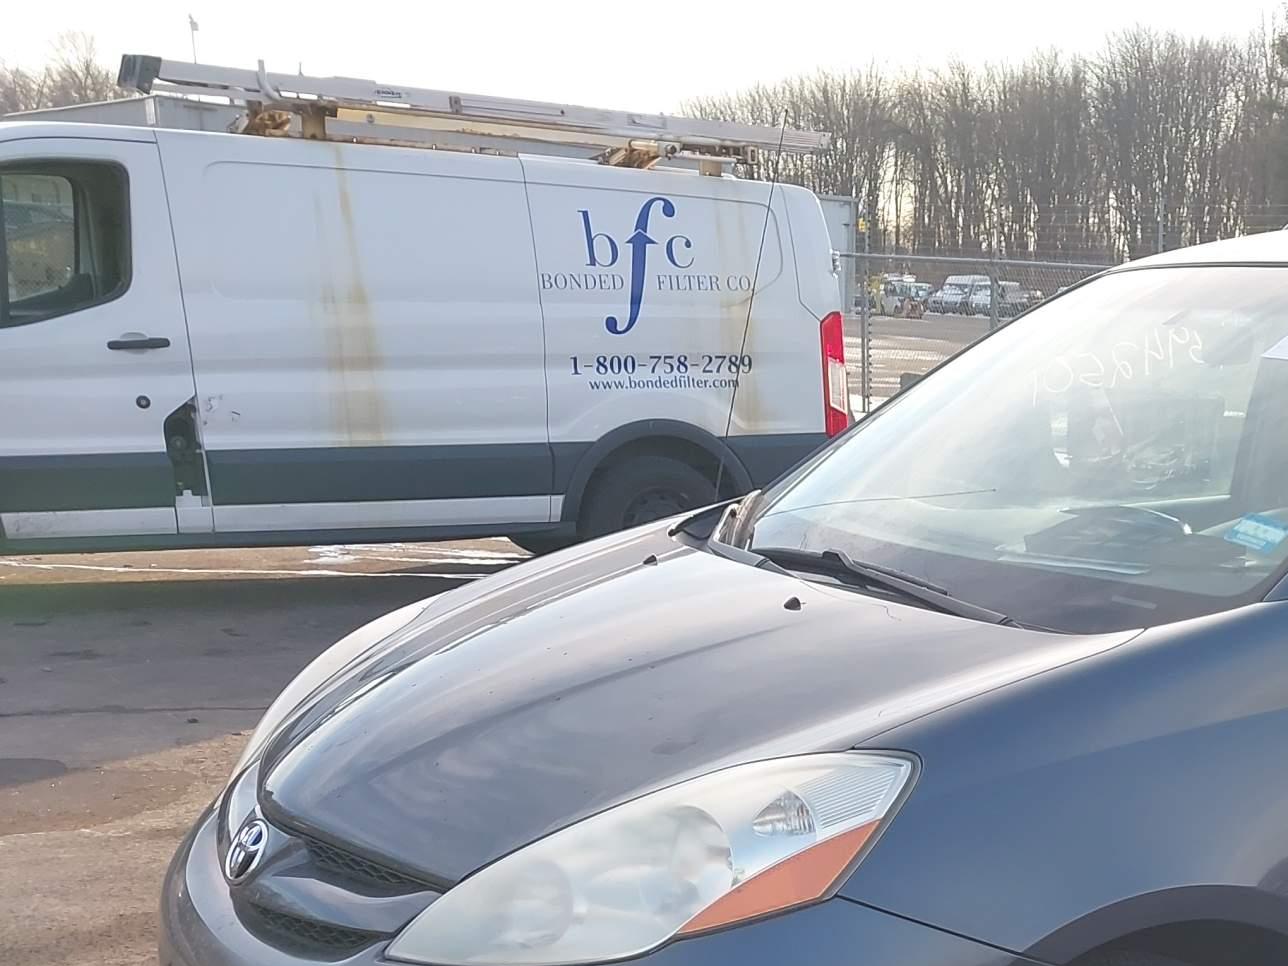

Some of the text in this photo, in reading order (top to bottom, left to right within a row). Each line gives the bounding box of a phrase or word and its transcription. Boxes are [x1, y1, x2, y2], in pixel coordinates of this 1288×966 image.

[577, 197, 696, 335] bfc
[541, 273, 624, 290] BONDED
[657, 275, 721, 291] FILTER
[570, 355, 753, 375] 1-800-758-2789
[588, 375, 739, 390] www.bondedfilter.com
